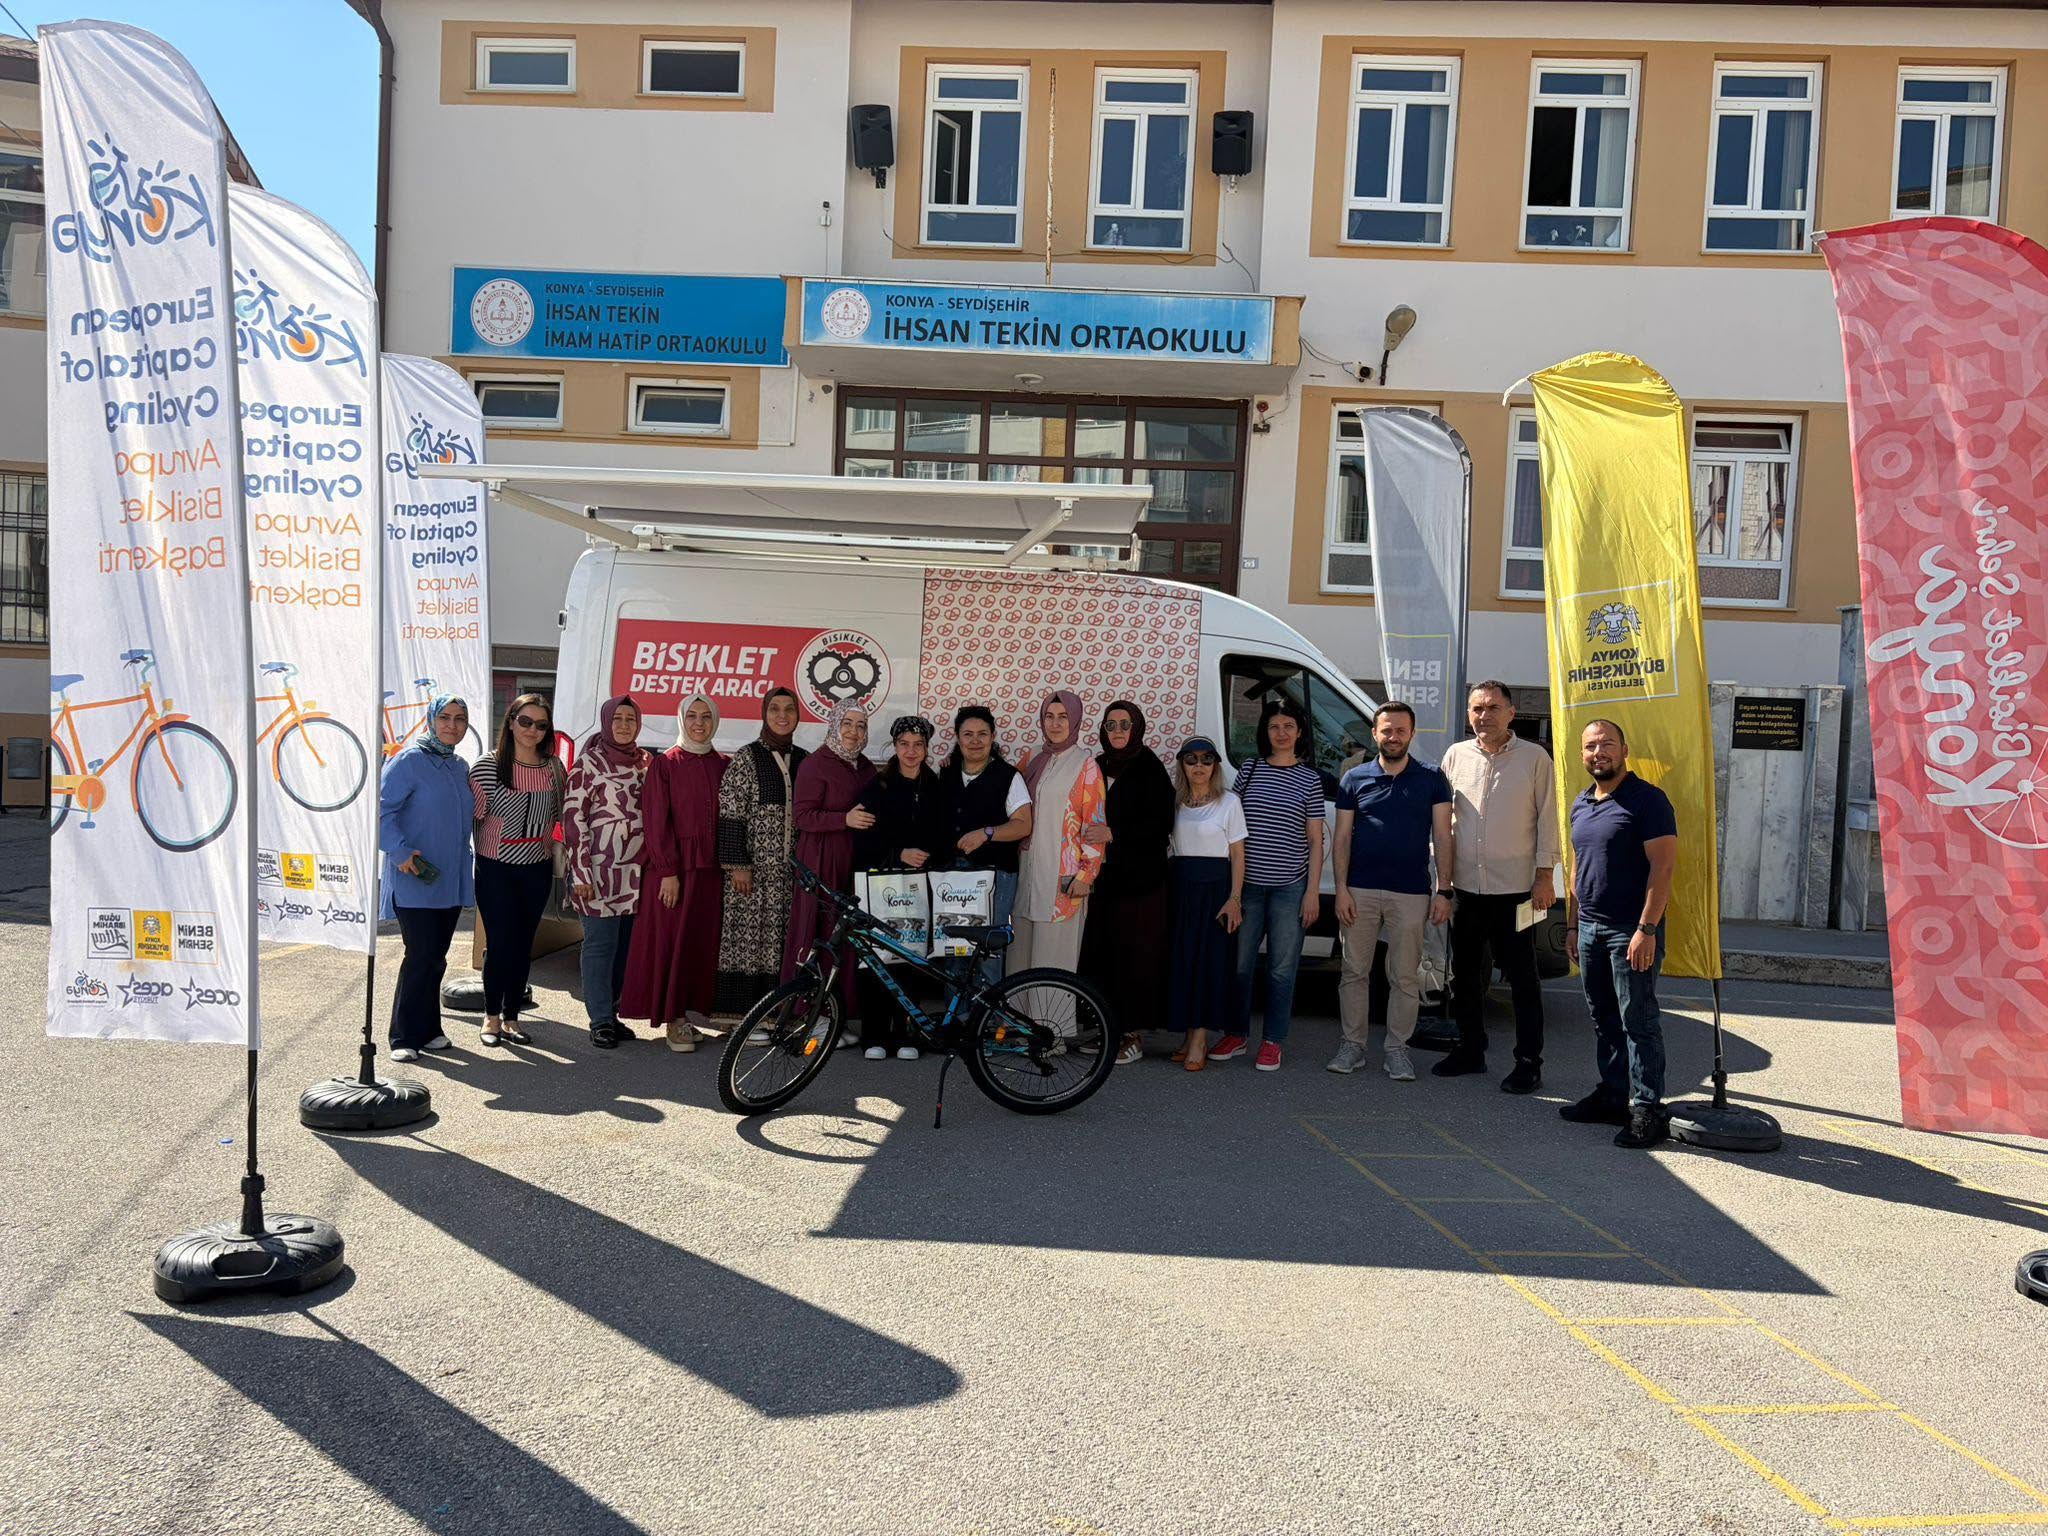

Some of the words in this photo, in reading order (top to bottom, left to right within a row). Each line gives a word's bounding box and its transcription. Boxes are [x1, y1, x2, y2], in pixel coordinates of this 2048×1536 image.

[546, 283, 585, 296] KONYA
[595, 284, 665, 298] SEYDİŞEHİR
[545, 299, 600, 321] İHSAN
[606, 303, 660, 324] TEKİN
[886, 294, 934, 308] KONYA
[947, 296, 1030, 313] SEYDİŞEHİR
[544, 326, 593, 348] İMAM
[599, 329, 651, 351] HATİP
[656, 334, 768, 355] ORTAOKULU
[884, 311, 970, 343] İHSAN
[979, 317, 1061, 347] TEKİN
[1070, 324, 1247, 354] ORTAOKULU
[629, 674, 710, 696] DESTEK
[710, 677, 774, 699] ARACI
[941, 889, 978, 908] Konya
